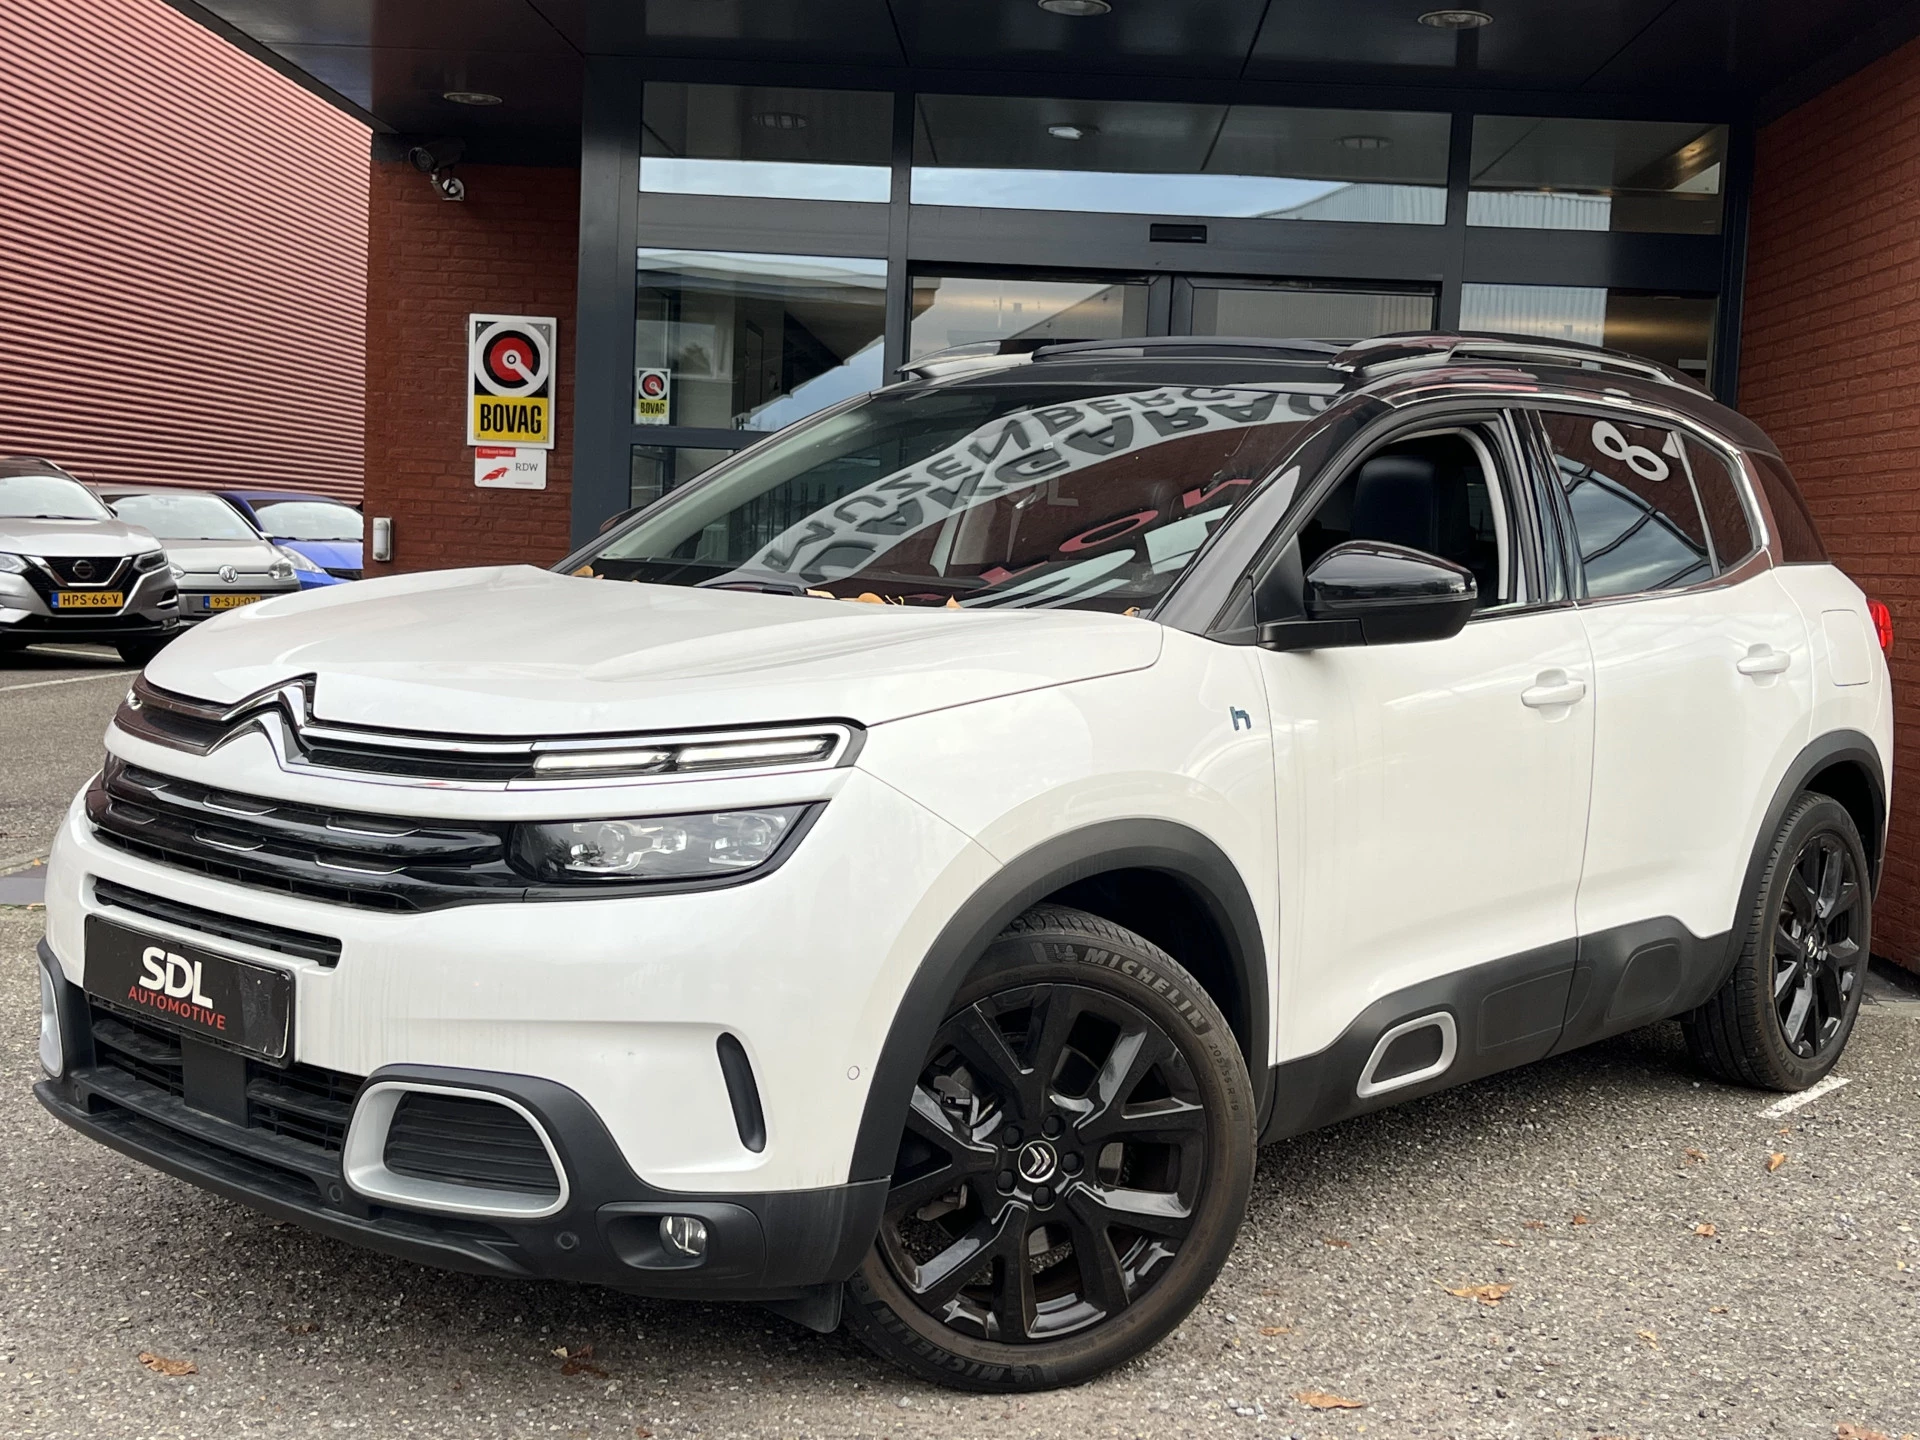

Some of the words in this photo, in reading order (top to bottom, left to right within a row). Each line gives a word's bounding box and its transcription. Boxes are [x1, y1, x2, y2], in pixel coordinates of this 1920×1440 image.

[480, 403, 542, 434] BOVAG
[640, 402, 665, 414] BOVAG
[515, 462, 538, 472] RDW
[62, 594, 119, 606] HPS-66-V
[138, 946, 214, 1010] SDL
[1083, 948, 1207, 1029] MICHELIN
[128, 985, 226, 1030] AUTOMOTIVE
[1208, 1043, 1232, 1084] 205/55
[1227, 1087, 1236, 1096] R
[871, 1306, 1006, 1381] MICHELIN
